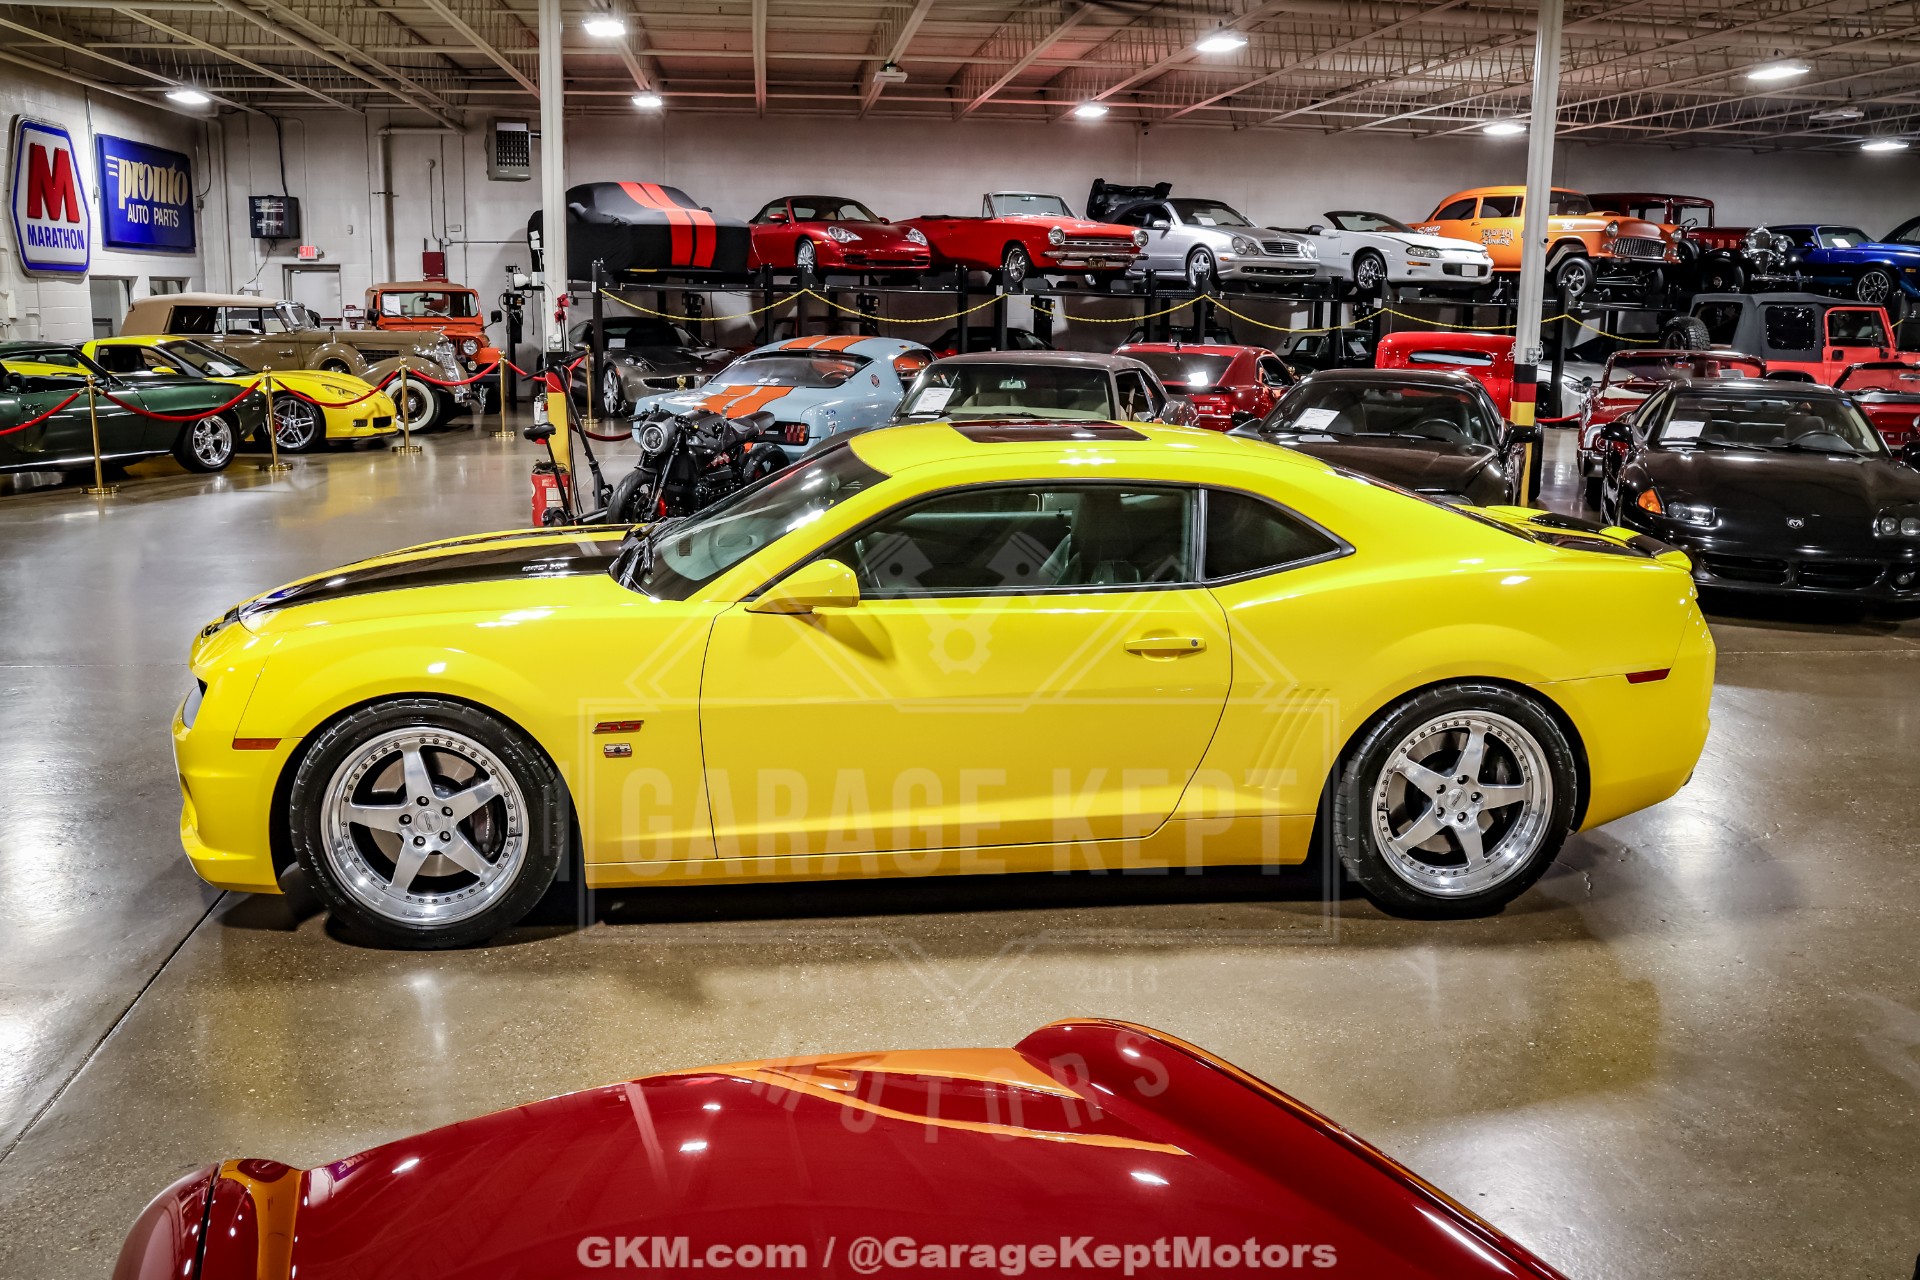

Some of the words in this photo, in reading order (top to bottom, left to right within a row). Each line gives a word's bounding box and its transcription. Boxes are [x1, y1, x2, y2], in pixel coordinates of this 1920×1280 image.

[27, 143, 80, 223] M
[118, 157, 189, 209] pronto
[127, 204, 149, 224] AUTO
[154, 209, 179, 228] PARTS
[27, 224, 85, 250] MARATHON
[300, 246, 315, 257] EXIT
